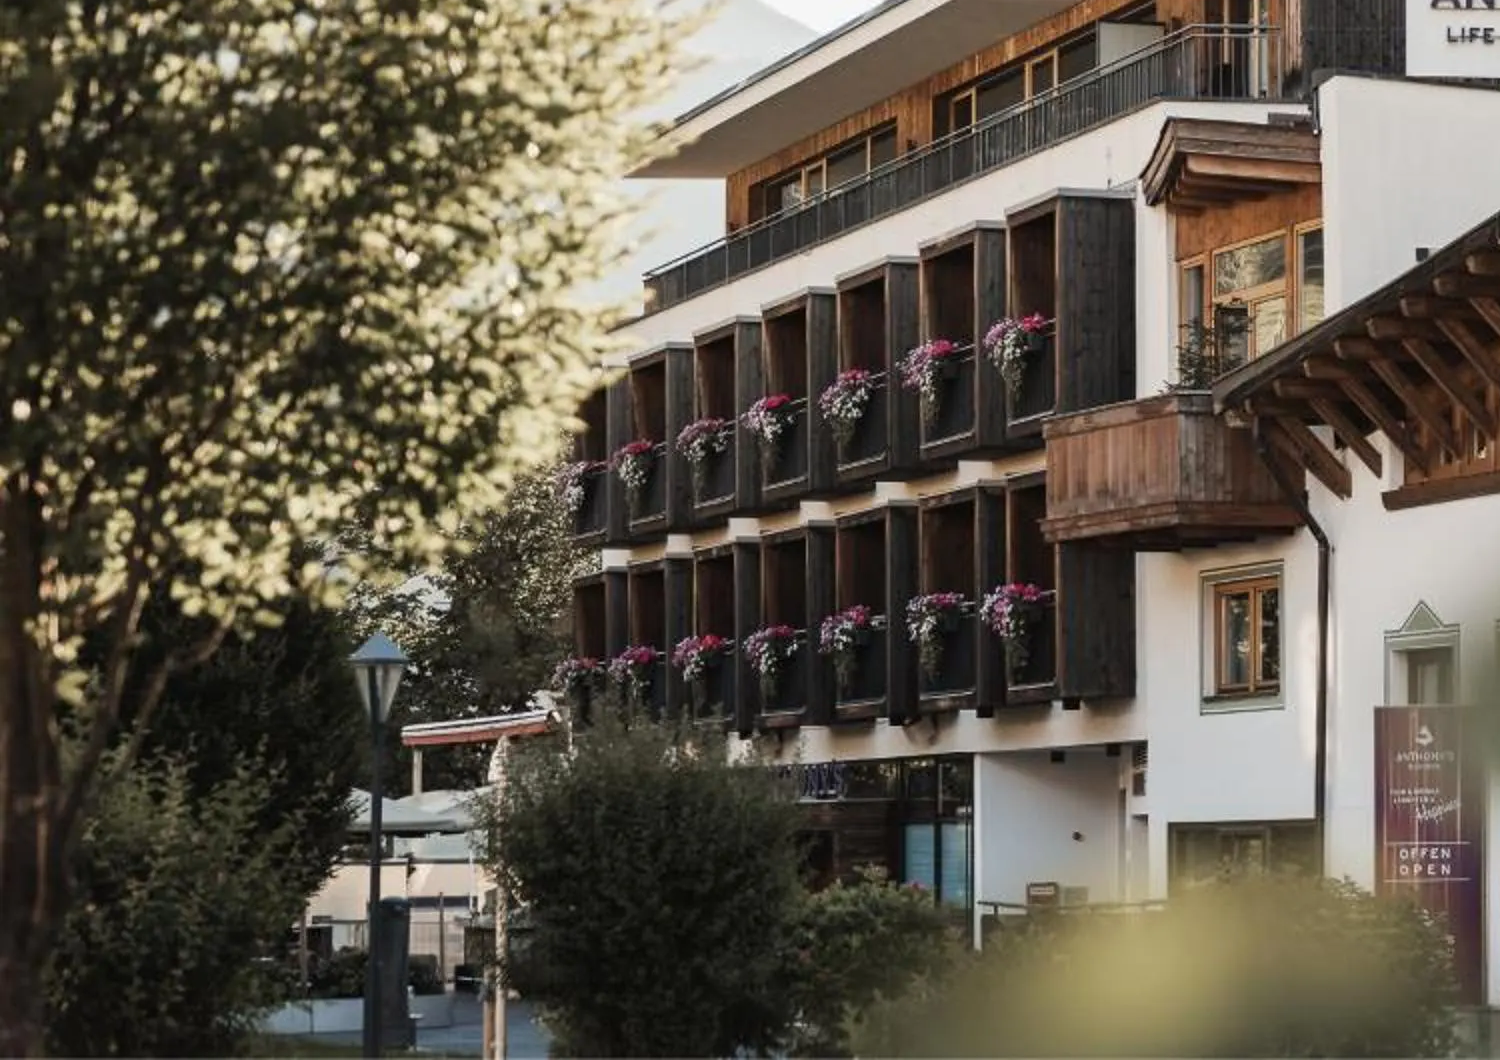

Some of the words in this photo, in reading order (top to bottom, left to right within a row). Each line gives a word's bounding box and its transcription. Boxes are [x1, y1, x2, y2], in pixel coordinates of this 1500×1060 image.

[1446, 27, 1495, 45] LIFE
[1400, 847, 1451, 861] OFFEN
[1400, 864, 1451, 877] OPEN
